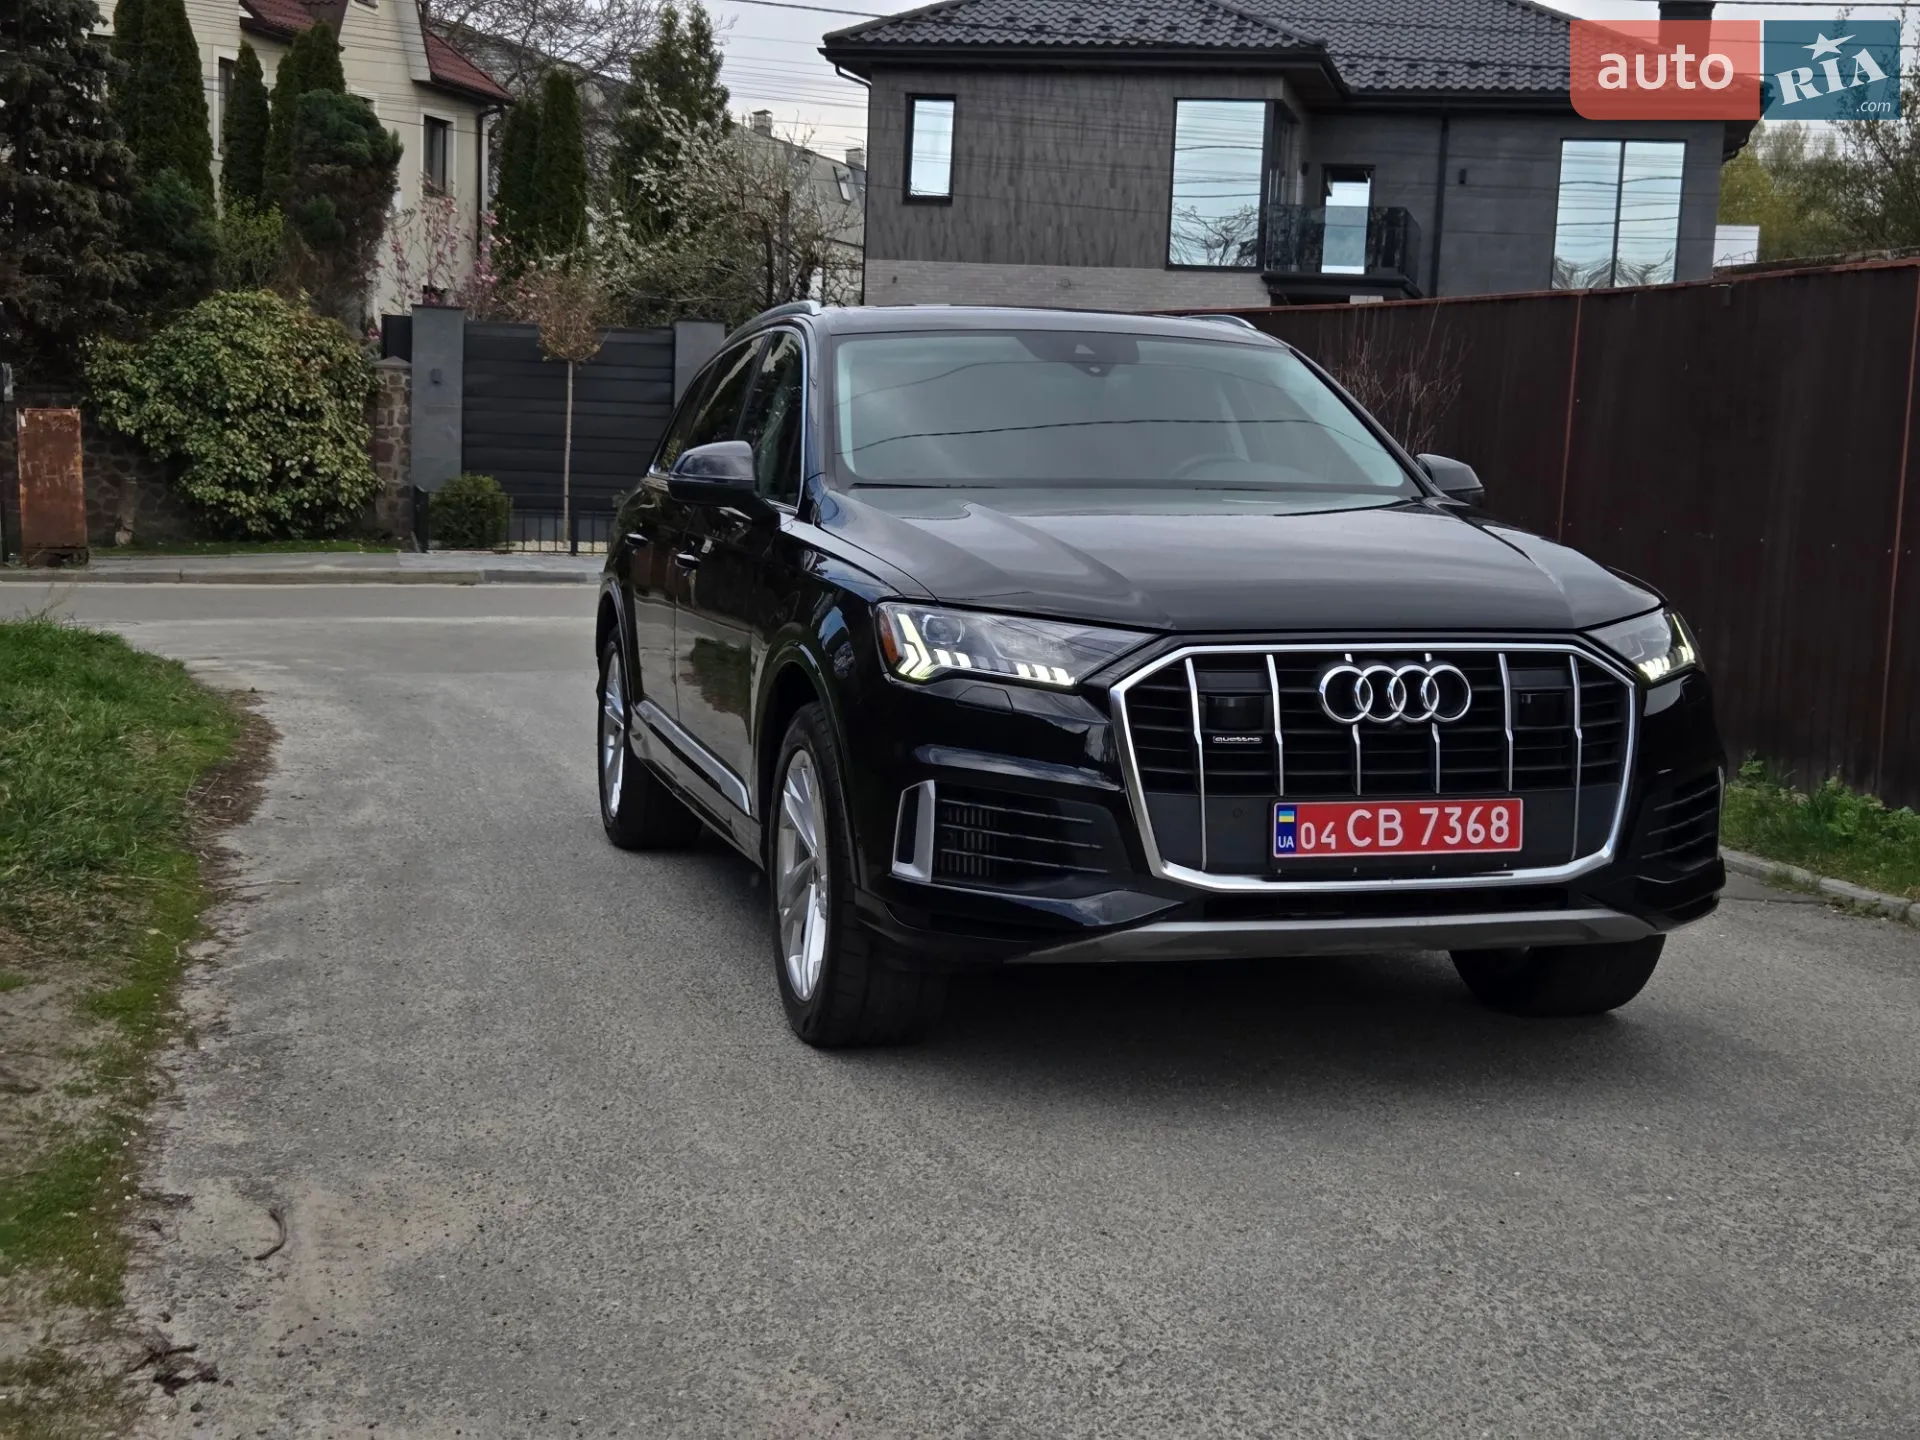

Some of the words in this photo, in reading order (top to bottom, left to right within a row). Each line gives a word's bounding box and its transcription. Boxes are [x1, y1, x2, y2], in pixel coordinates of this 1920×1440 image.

[1214, 736, 1261, 744] quattro
[1300, 822, 1336, 849] 04
[1347, 809, 1403, 847] CB
[1419, 806, 1510, 846] 7368
[1278, 836, 1294, 848] UA
